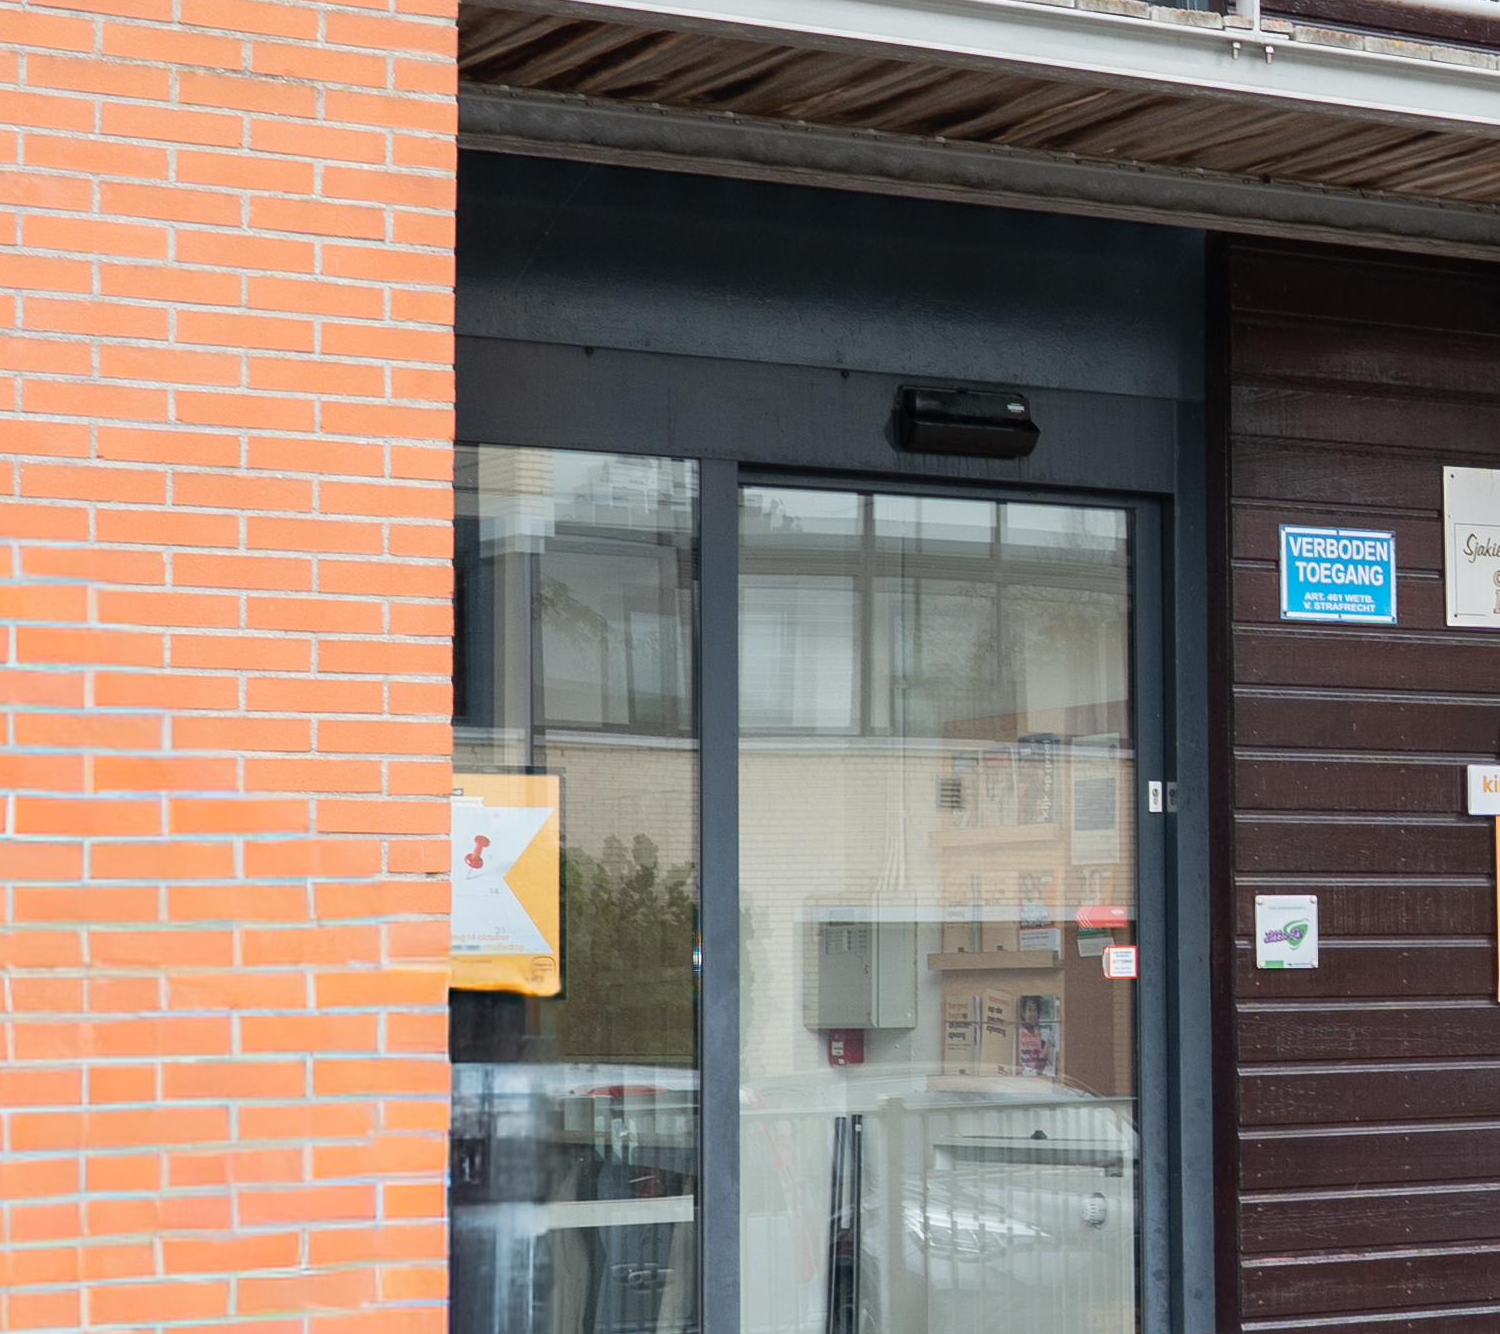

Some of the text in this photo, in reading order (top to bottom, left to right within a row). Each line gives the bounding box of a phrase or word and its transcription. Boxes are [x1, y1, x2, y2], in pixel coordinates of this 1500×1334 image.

[1288, 536, 1389, 562] VERBODEN
[1294, 561, 1384, 586] TOEGANG
[1304, 592, 1326, 601] ART.
[1313, 602, 1376, 612] STRAFRECHT
